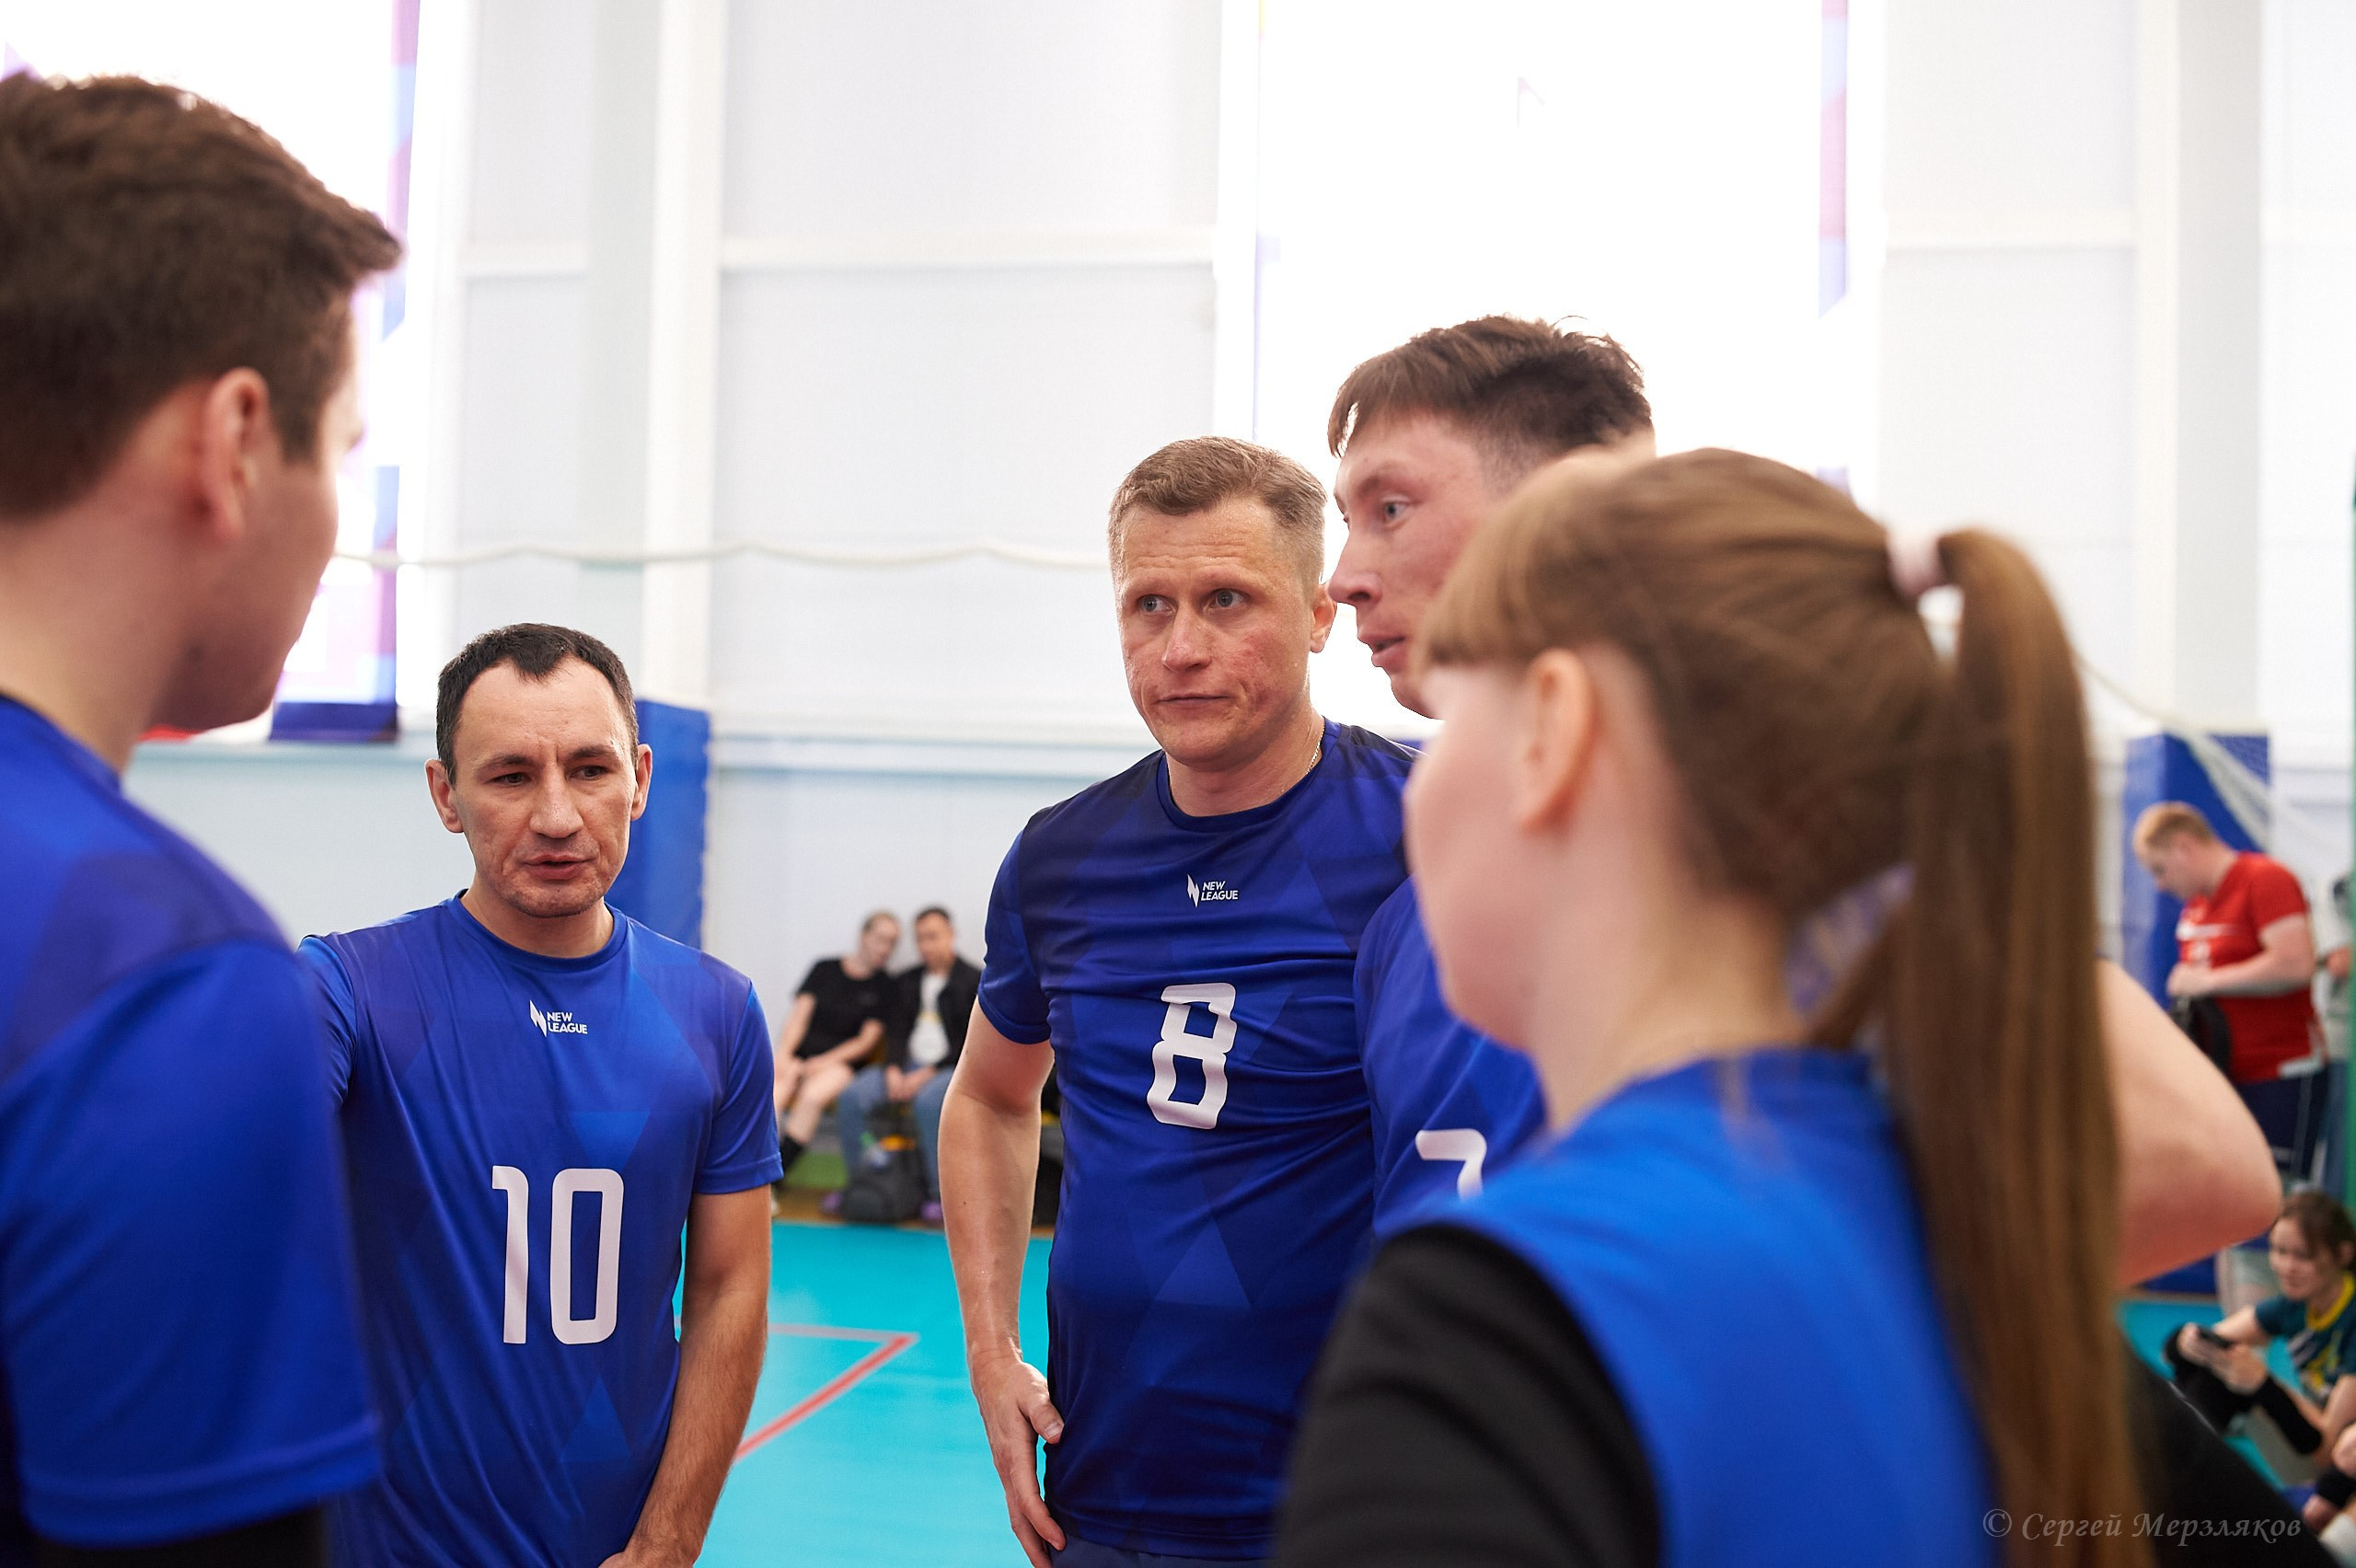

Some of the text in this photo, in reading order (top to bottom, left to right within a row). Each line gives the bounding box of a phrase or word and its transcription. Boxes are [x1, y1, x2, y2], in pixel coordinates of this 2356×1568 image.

[1202, 881, 1226, 891] NEW
[1200, 890, 1239, 901] LEAGUE
[547, 1011, 572, 1022] NEW
[547, 1021, 588, 1034] LEAGUE
[1147, 982, 1237, 1130] 8
[491, 1165, 624, 1344] 10
